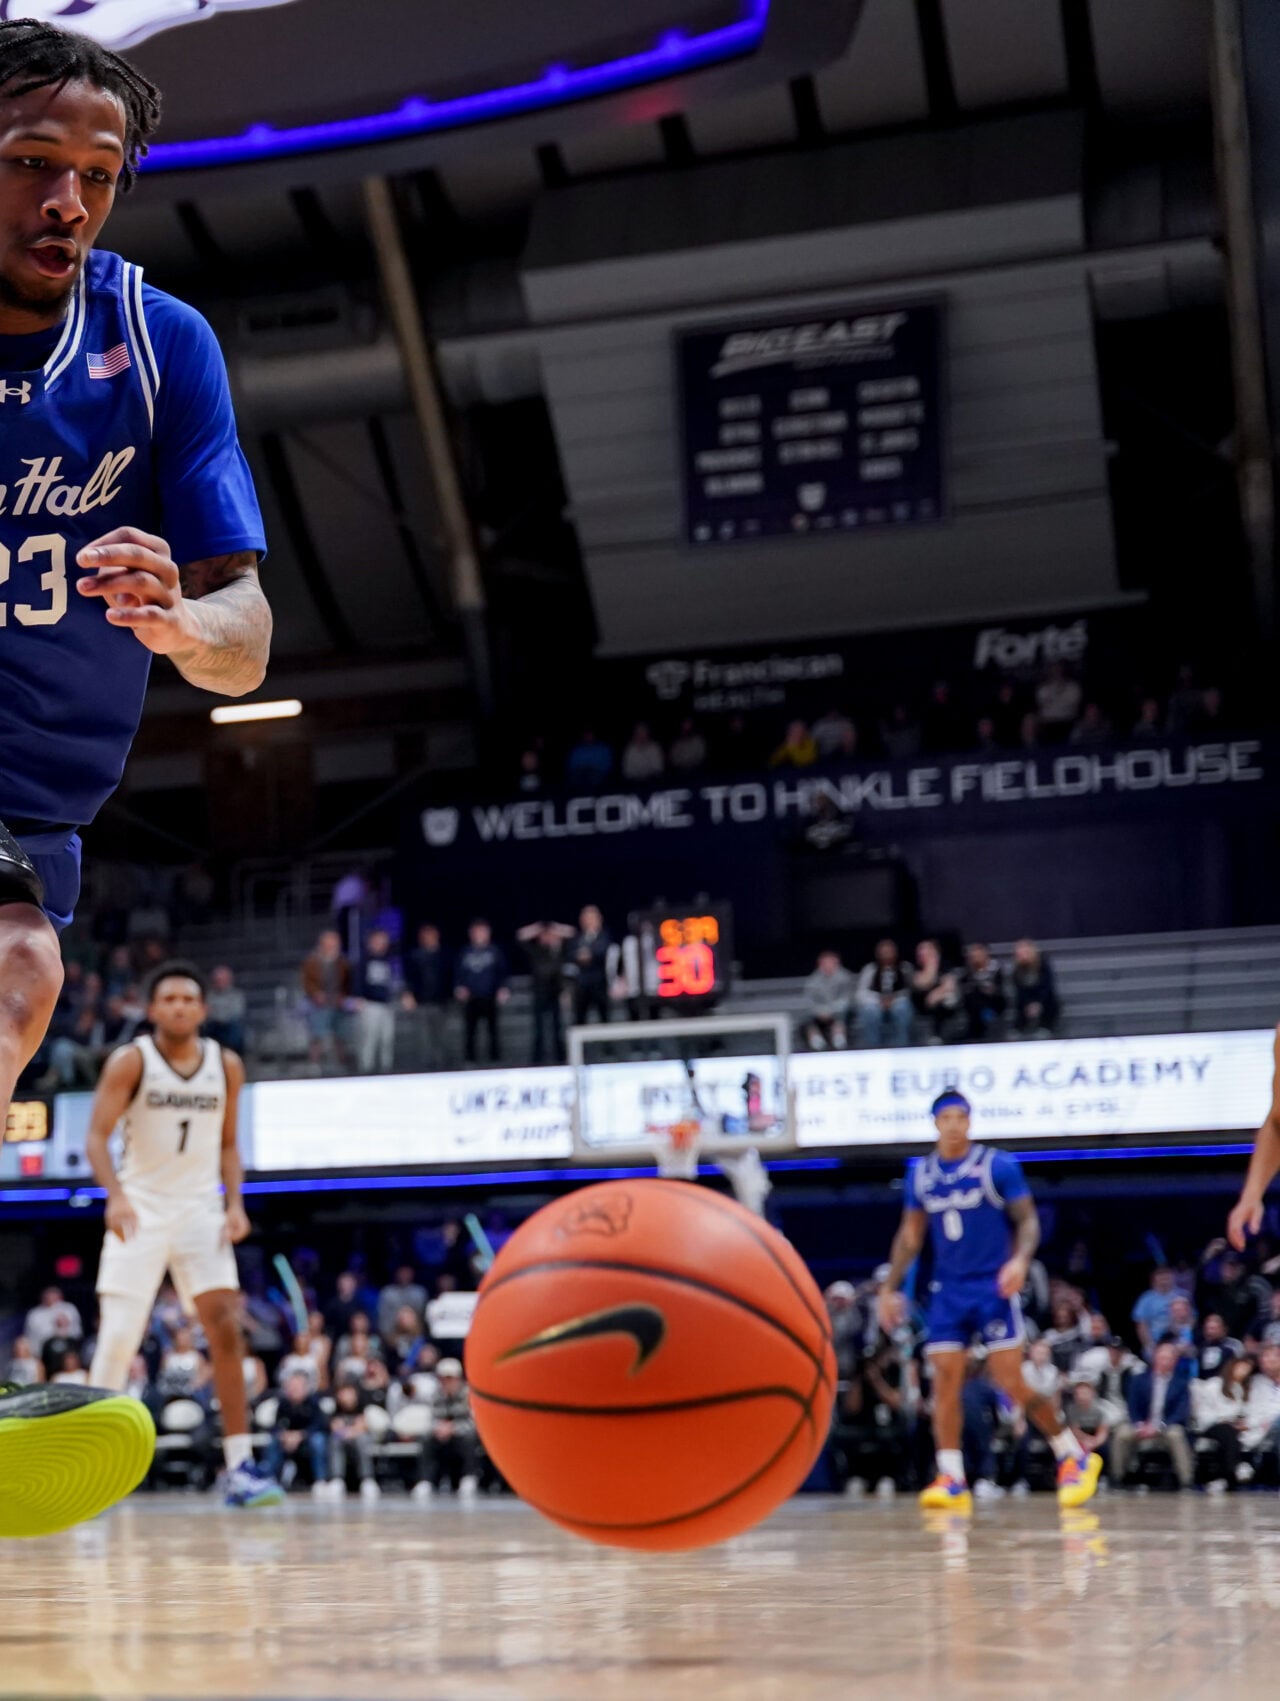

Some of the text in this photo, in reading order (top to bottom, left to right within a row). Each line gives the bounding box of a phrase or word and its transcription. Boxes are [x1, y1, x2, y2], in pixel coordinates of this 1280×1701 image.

[11, 446, 136, 517] Hall
[974, 619, 1088, 669] Forté
[472, 739, 1263, 842] WELCOME TO HINKLE FIELDHOUSE
[656, 943, 715, 997] 30
[889, 1066, 995, 1098] EURO
[1011, 1054, 1212, 1092] ACADEMY
[177, 1118, 191, 1154] 1
[942, 1208, 964, 1241] 0
